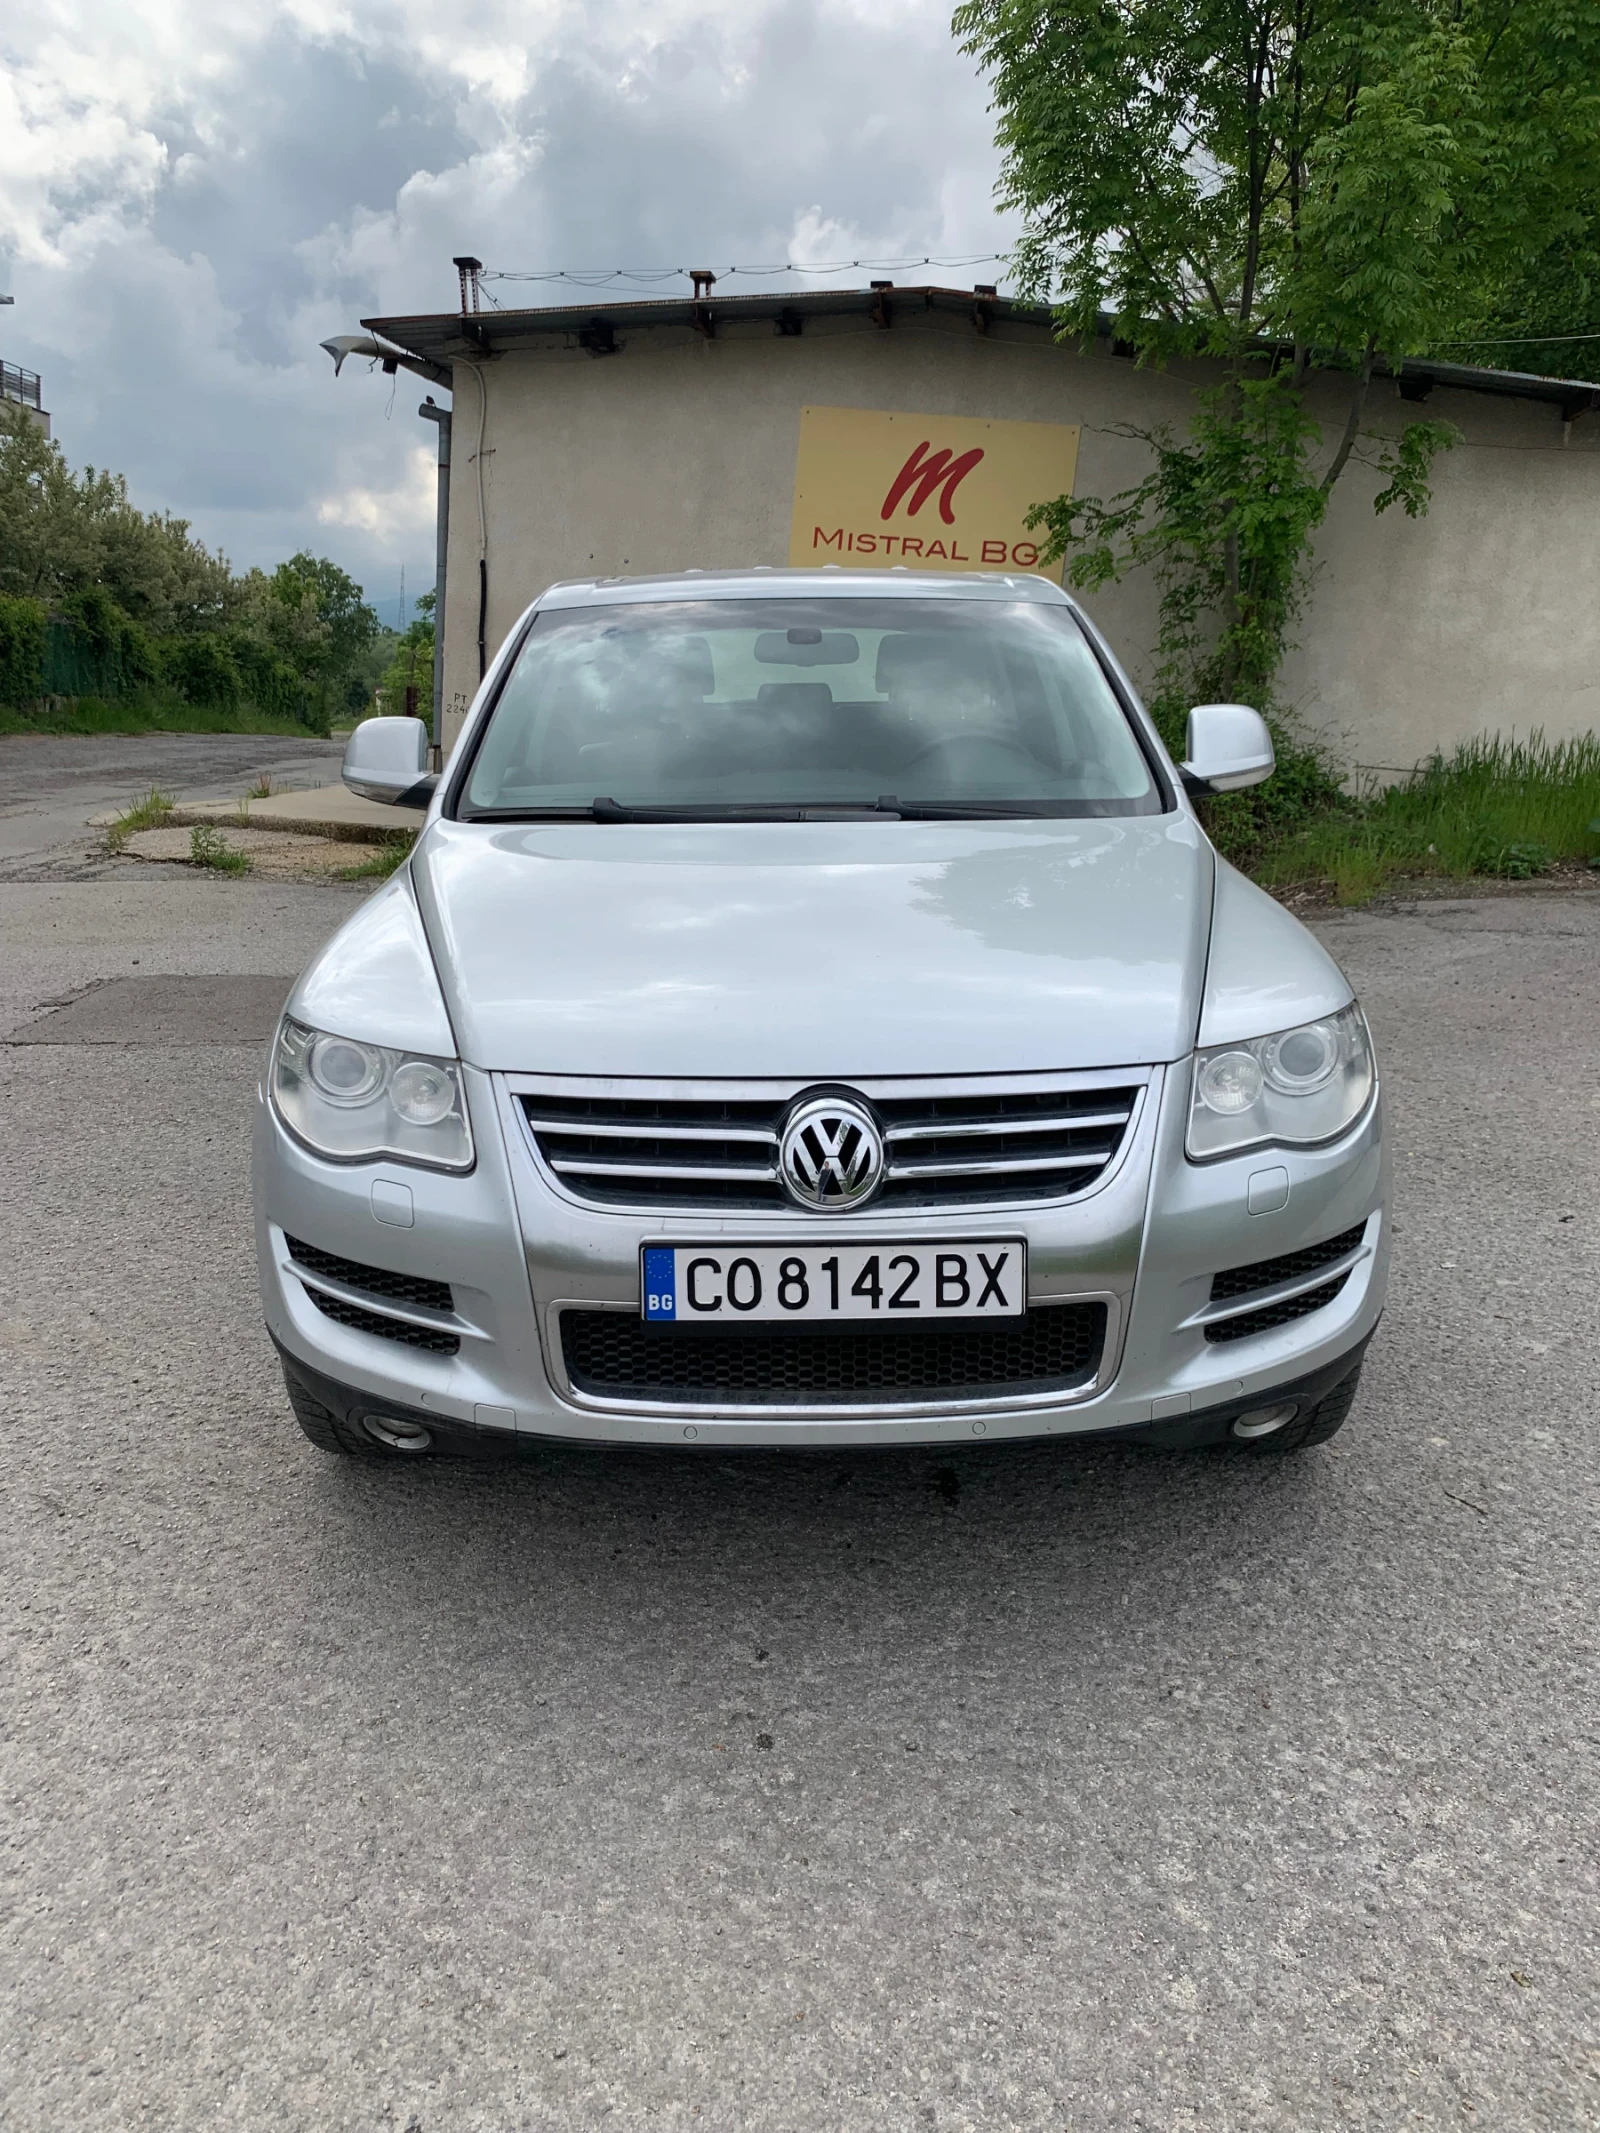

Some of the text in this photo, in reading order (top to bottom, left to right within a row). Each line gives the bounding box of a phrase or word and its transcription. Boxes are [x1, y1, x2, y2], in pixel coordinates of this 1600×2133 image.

[812, 526, 1040, 567] MISTRAL BG
[789, 1106, 876, 1201] VW
[648, 1294, 673, 1310] BG
[777, 1255, 921, 1311] 8142
[935, 1252, 1010, 1308] BX
